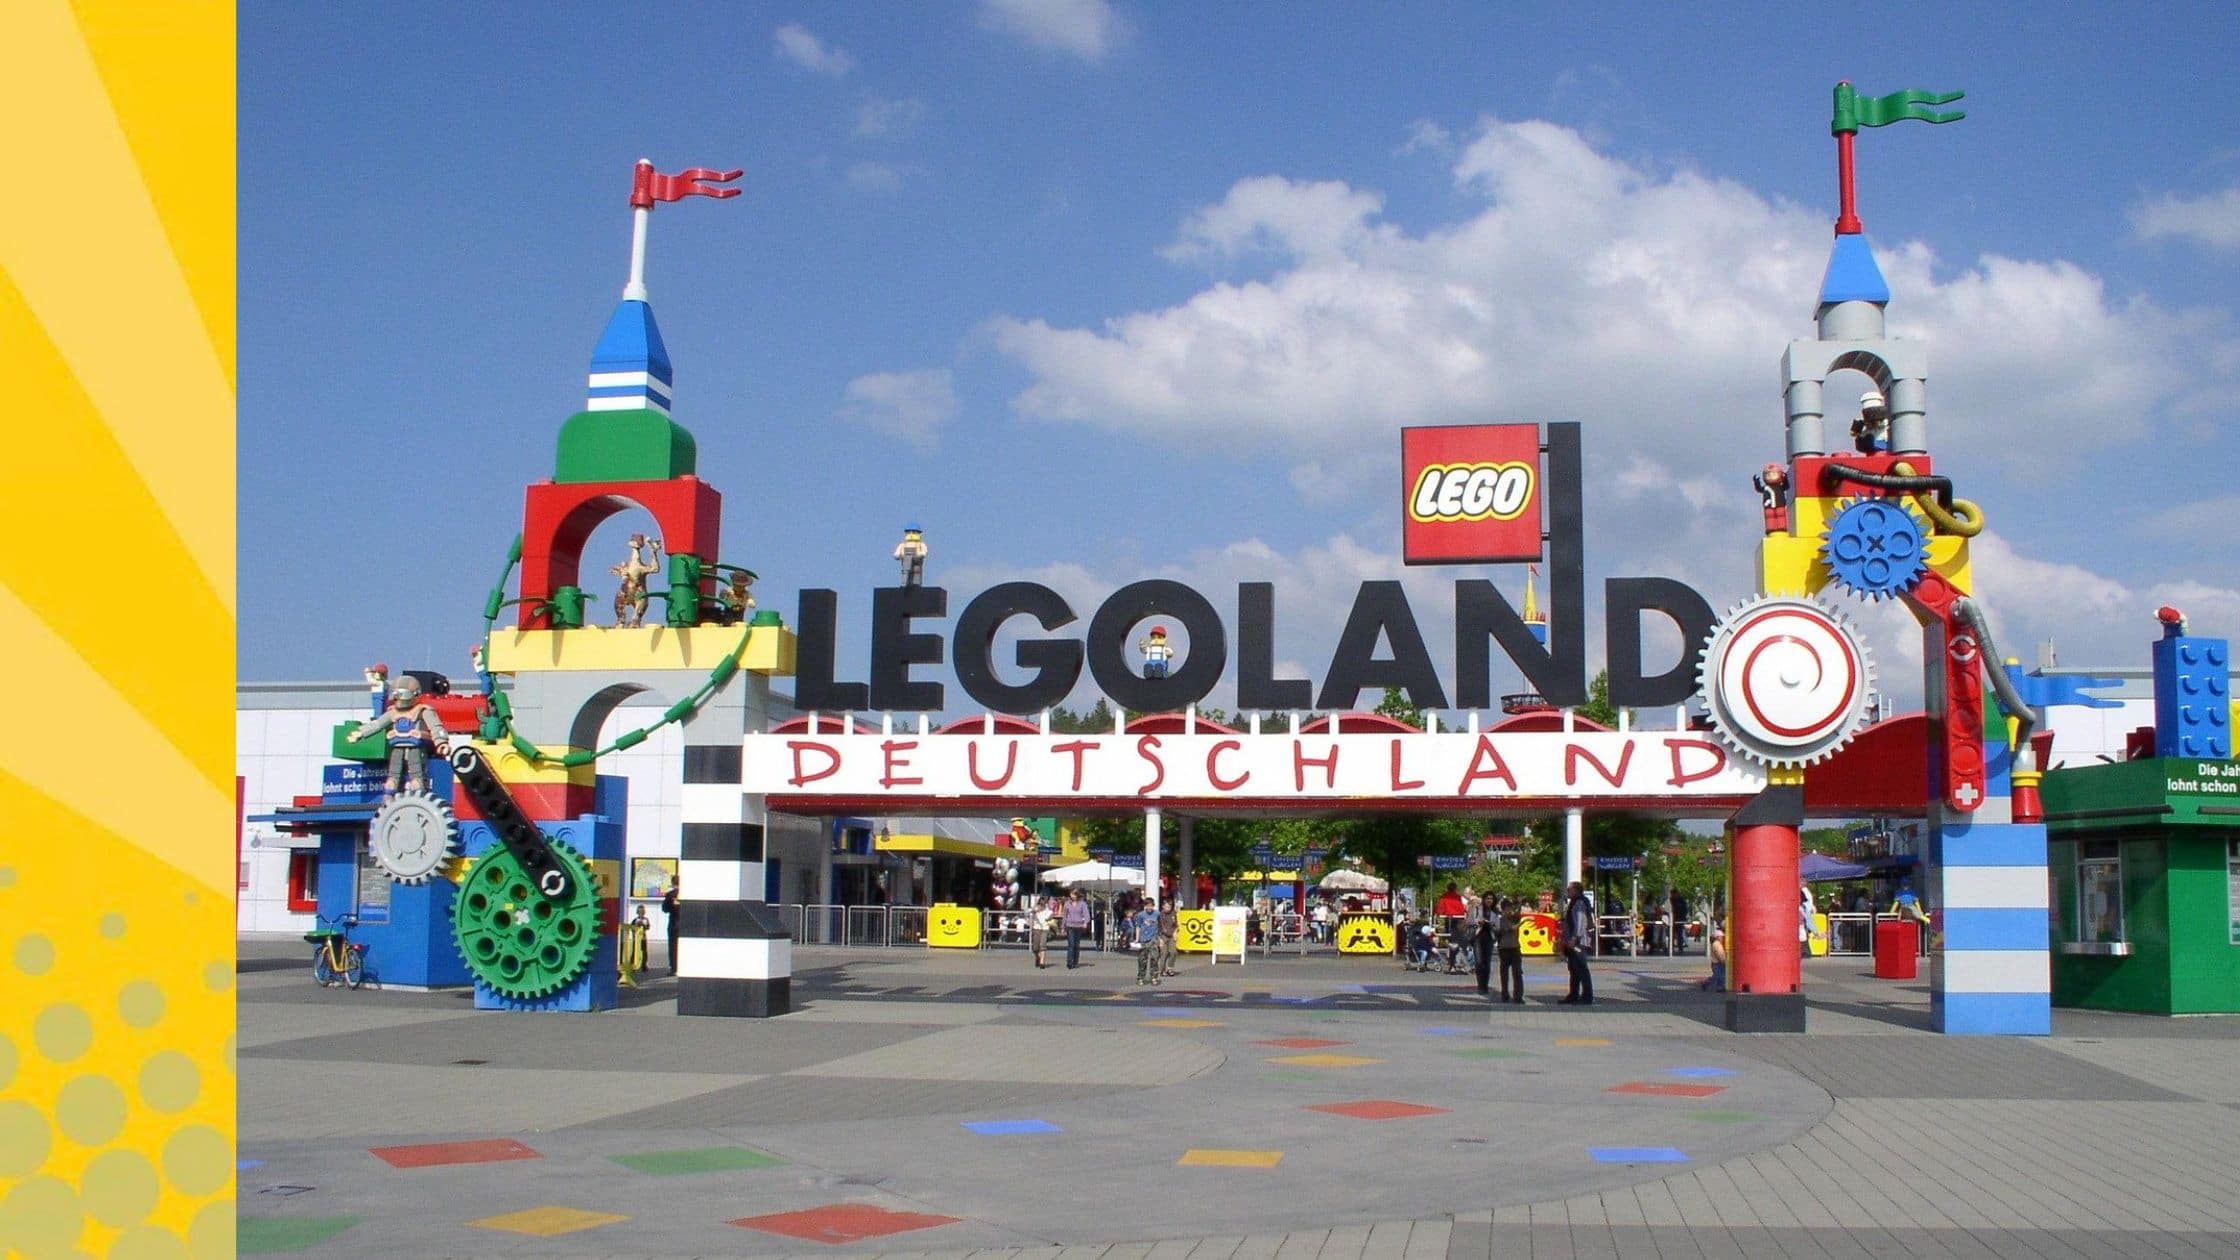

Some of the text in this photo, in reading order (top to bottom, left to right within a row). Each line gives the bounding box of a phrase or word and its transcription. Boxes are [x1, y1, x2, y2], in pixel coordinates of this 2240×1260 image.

[1415, 467, 1528, 516] LEGO
[797, 577, 1717, 713] LEGOLAND
[788, 731, 1727, 796] DEUTSCHLAND
[2198, 763, 2218, 776] Die
[342, 768, 356, 779] Die
[322, 782, 342, 794] lohnt
[344, 780, 367, 793] schon
[2167, 778, 2237, 793] lohnt schon
